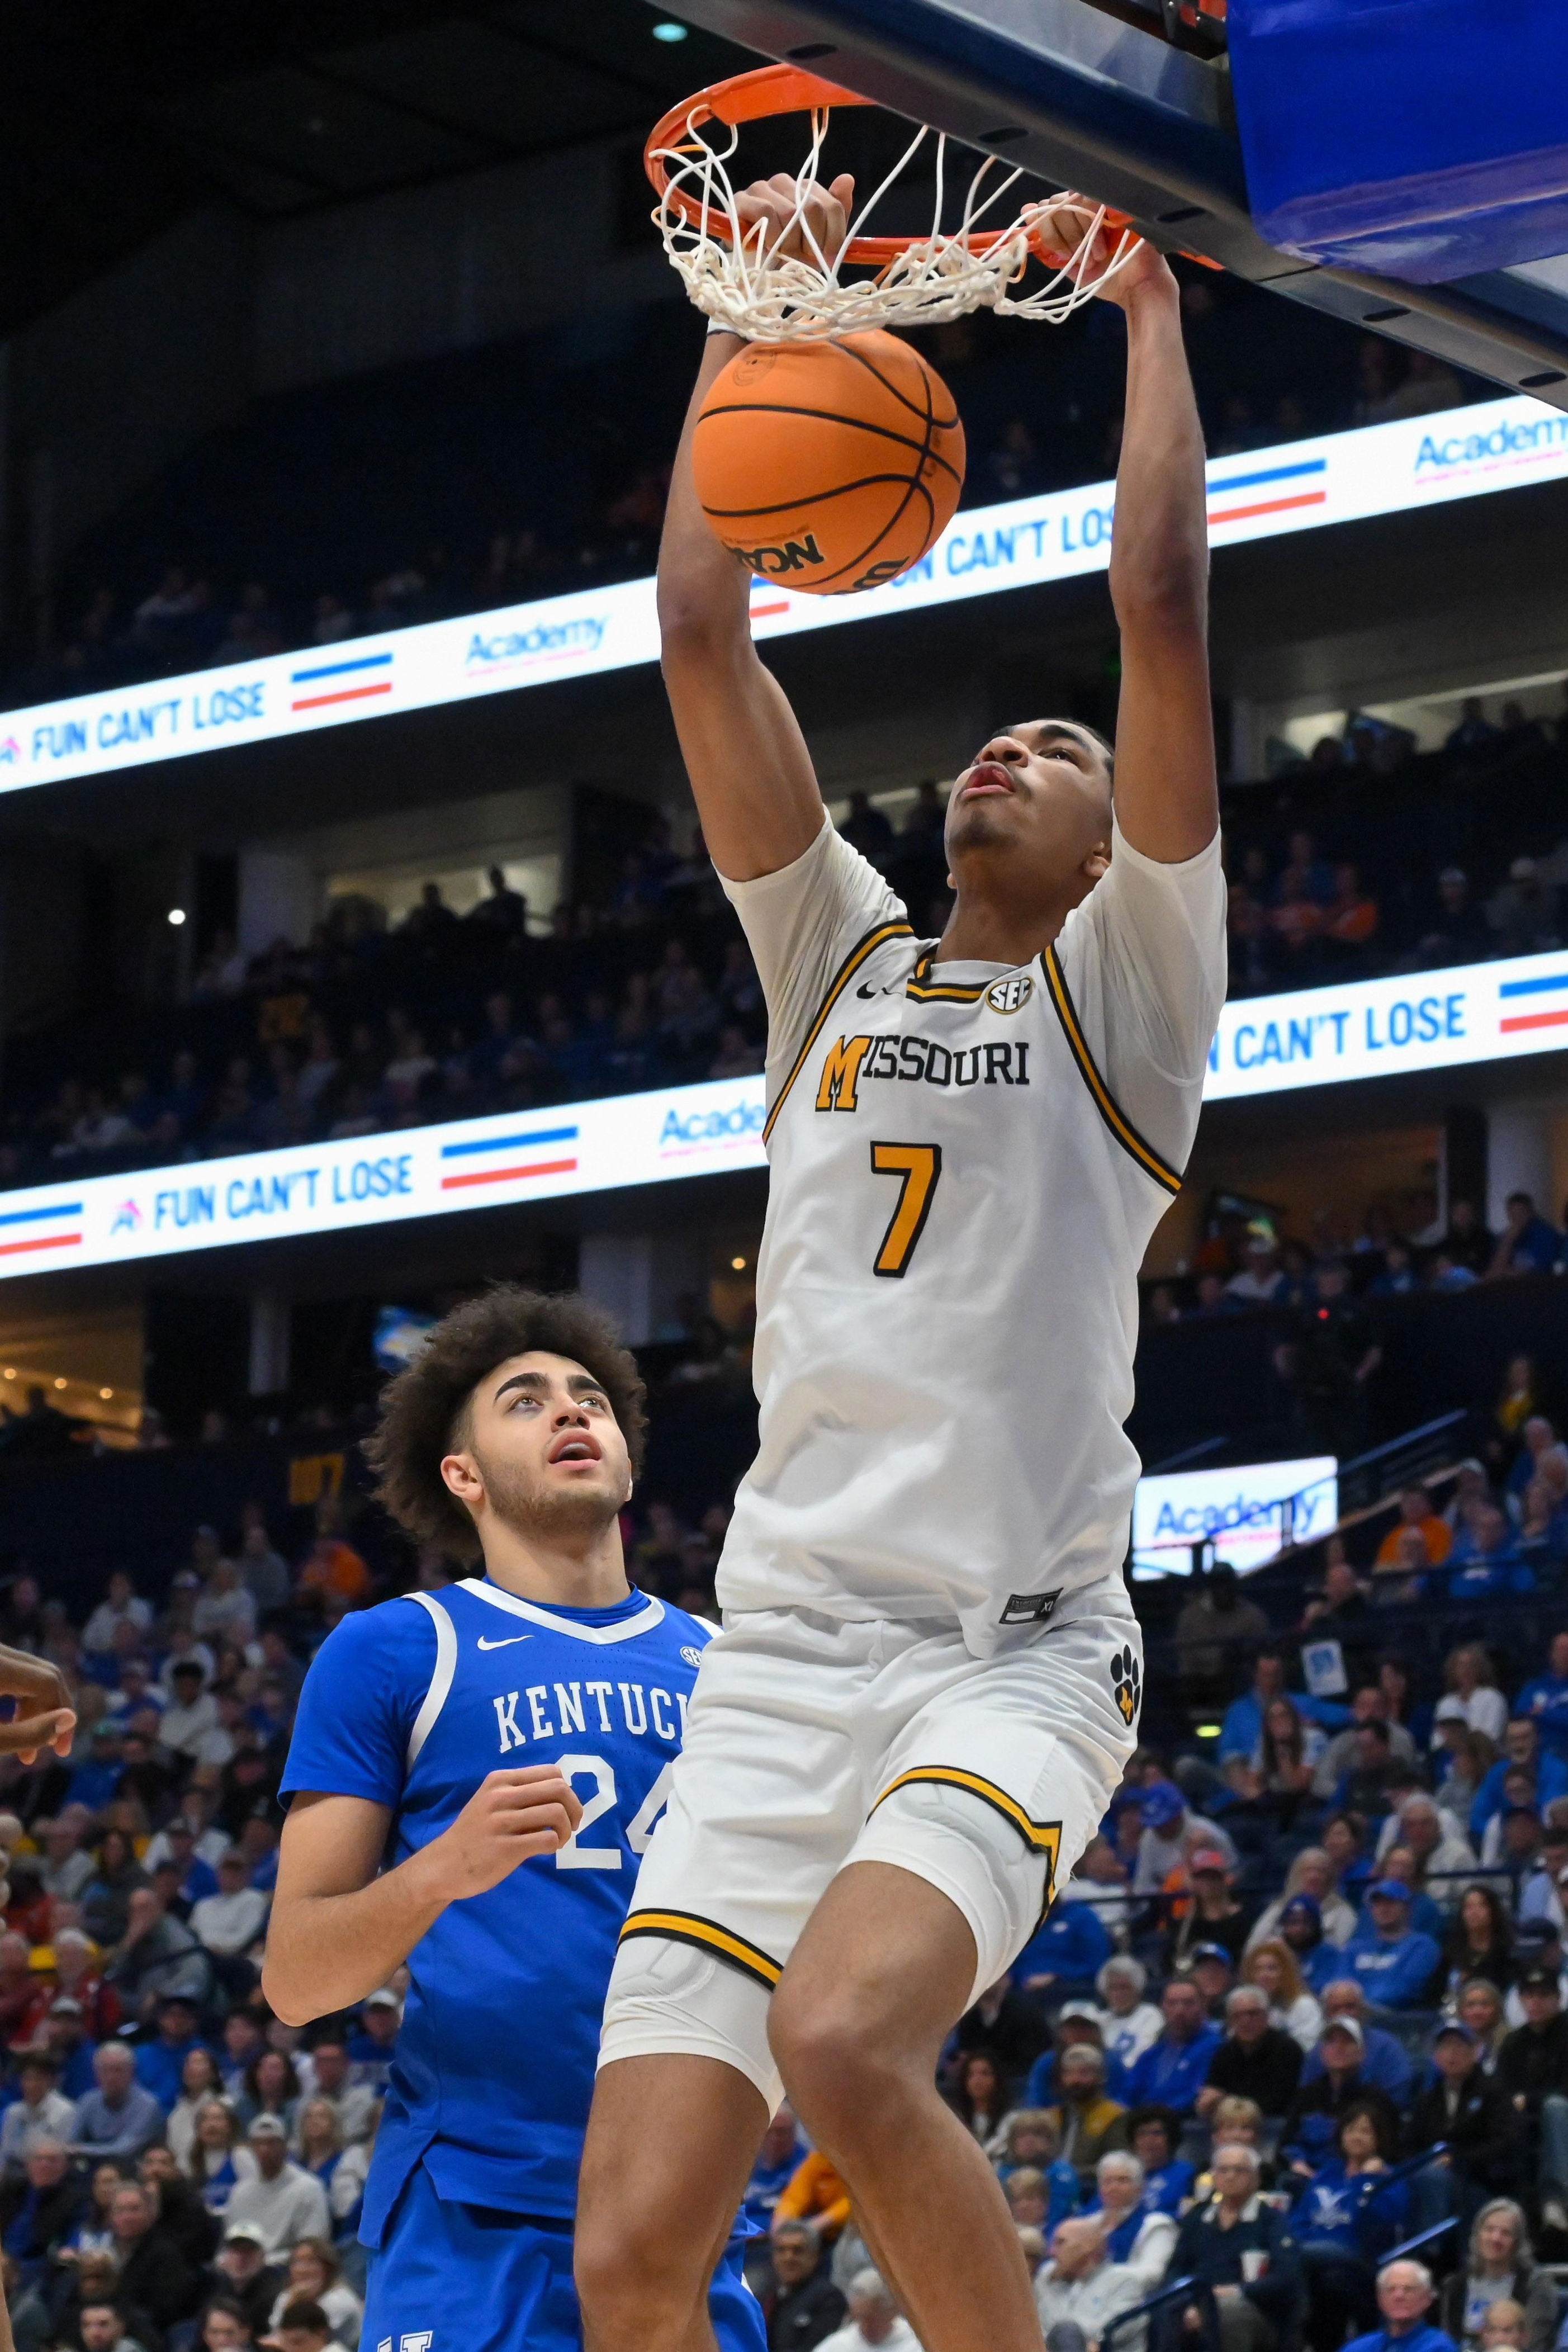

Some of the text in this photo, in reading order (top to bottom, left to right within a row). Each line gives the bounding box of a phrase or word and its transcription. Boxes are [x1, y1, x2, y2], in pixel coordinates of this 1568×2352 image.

[1415, 417, 1568, 471] Academ
[947, 518, 1049, 576] CAN'T
[466, 613, 610, 665] Academy
[33, 721, 87, 761] FUN
[97, 698, 182, 749] CAN'T
[193, 680, 266, 729] LOSE
[989, 978, 1031, 1011] SEC
[1233, 1010, 1351, 1070] CAN'T
[1366, 992, 1467, 1051] LOSE
[814, 1034, 1030, 1113] MISSOURI
[155, 1184, 216, 1230] FUN
[226, 1168, 320, 1220] CAN'T
[333, 1154, 413, 1204] LOSE
[870, 1140, 942, 1279] 7
